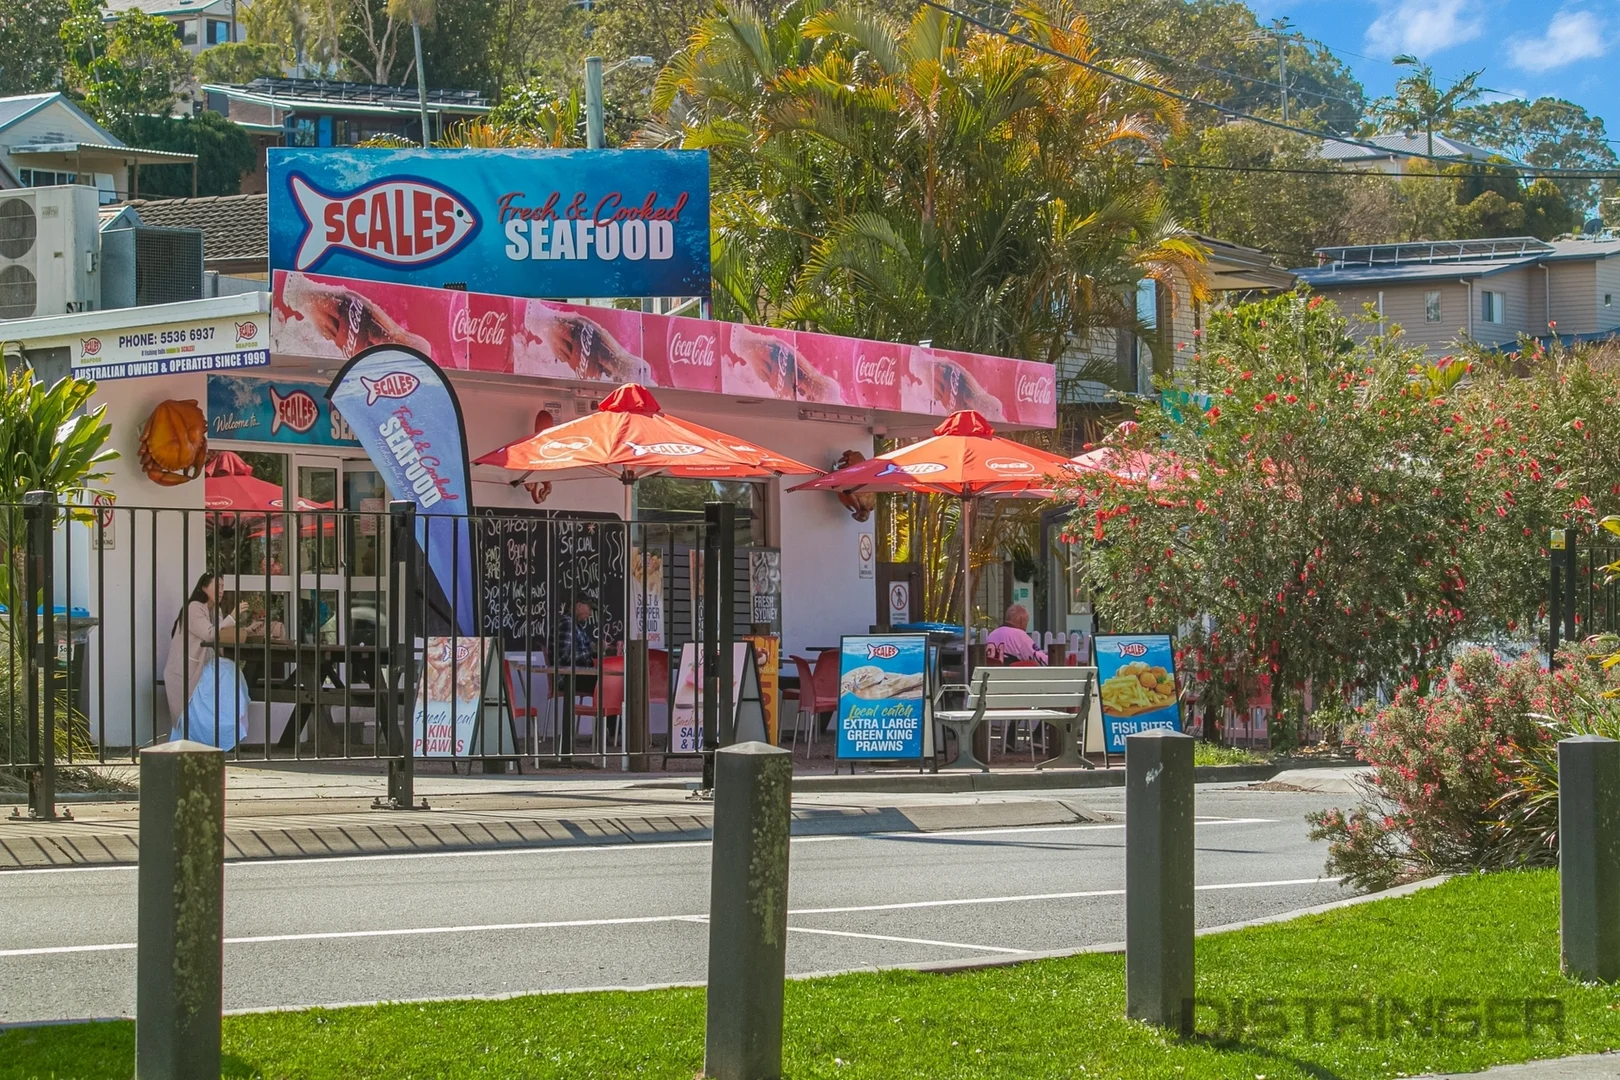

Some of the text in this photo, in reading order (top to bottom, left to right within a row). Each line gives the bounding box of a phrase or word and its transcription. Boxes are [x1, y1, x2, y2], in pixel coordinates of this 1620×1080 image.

[496, 191, 689, 228] Fresh & Cooked
[324, 189, 455, 256] SCALES
[505, 219, 674, 260] SEAFOOD
[452, 308, 508, 345] Coca-Cola
[119, 327, 215, 348] PHONE: 5536 6937
[670, 333, 715, 366] Coca-Cola
[74, 351, 266, 380] AUSTRALIAN OWNED & OPERATED SINCE 1999
[856, 355, 896, 386] Coca-Cola
[373, 376, 413, 396] SCALES
[1017, 374, 1052, 405] Coca-Cola
[279, 394, 315, 430] SCALES
[213, 414, 249, 432] Welcome
[379, 417, 441, 508] SEAFOOD
[392, 405, 459, 501] Fresh & Cooked
[560, 536, 595, 554] SPCIAL
[754, 596, 773, 608] FRESH
[754, 608, 778, 620] SYDNEY
[639, 619, 658, 632] SUID
[873, 646, 896, 656] SCALES
[1123, 644, 1145, 655] SCALES
[847, 702, 913, 720] Local catch
[843, 718, 918, 730] EXTRA LARGE
[1111, 721, 1137, 734] FISH
[847, 729, 913, 741] GREEN KING
[1113, 734, 1127, 746] AN
[855, 741, 903, 752] PRAWNS
